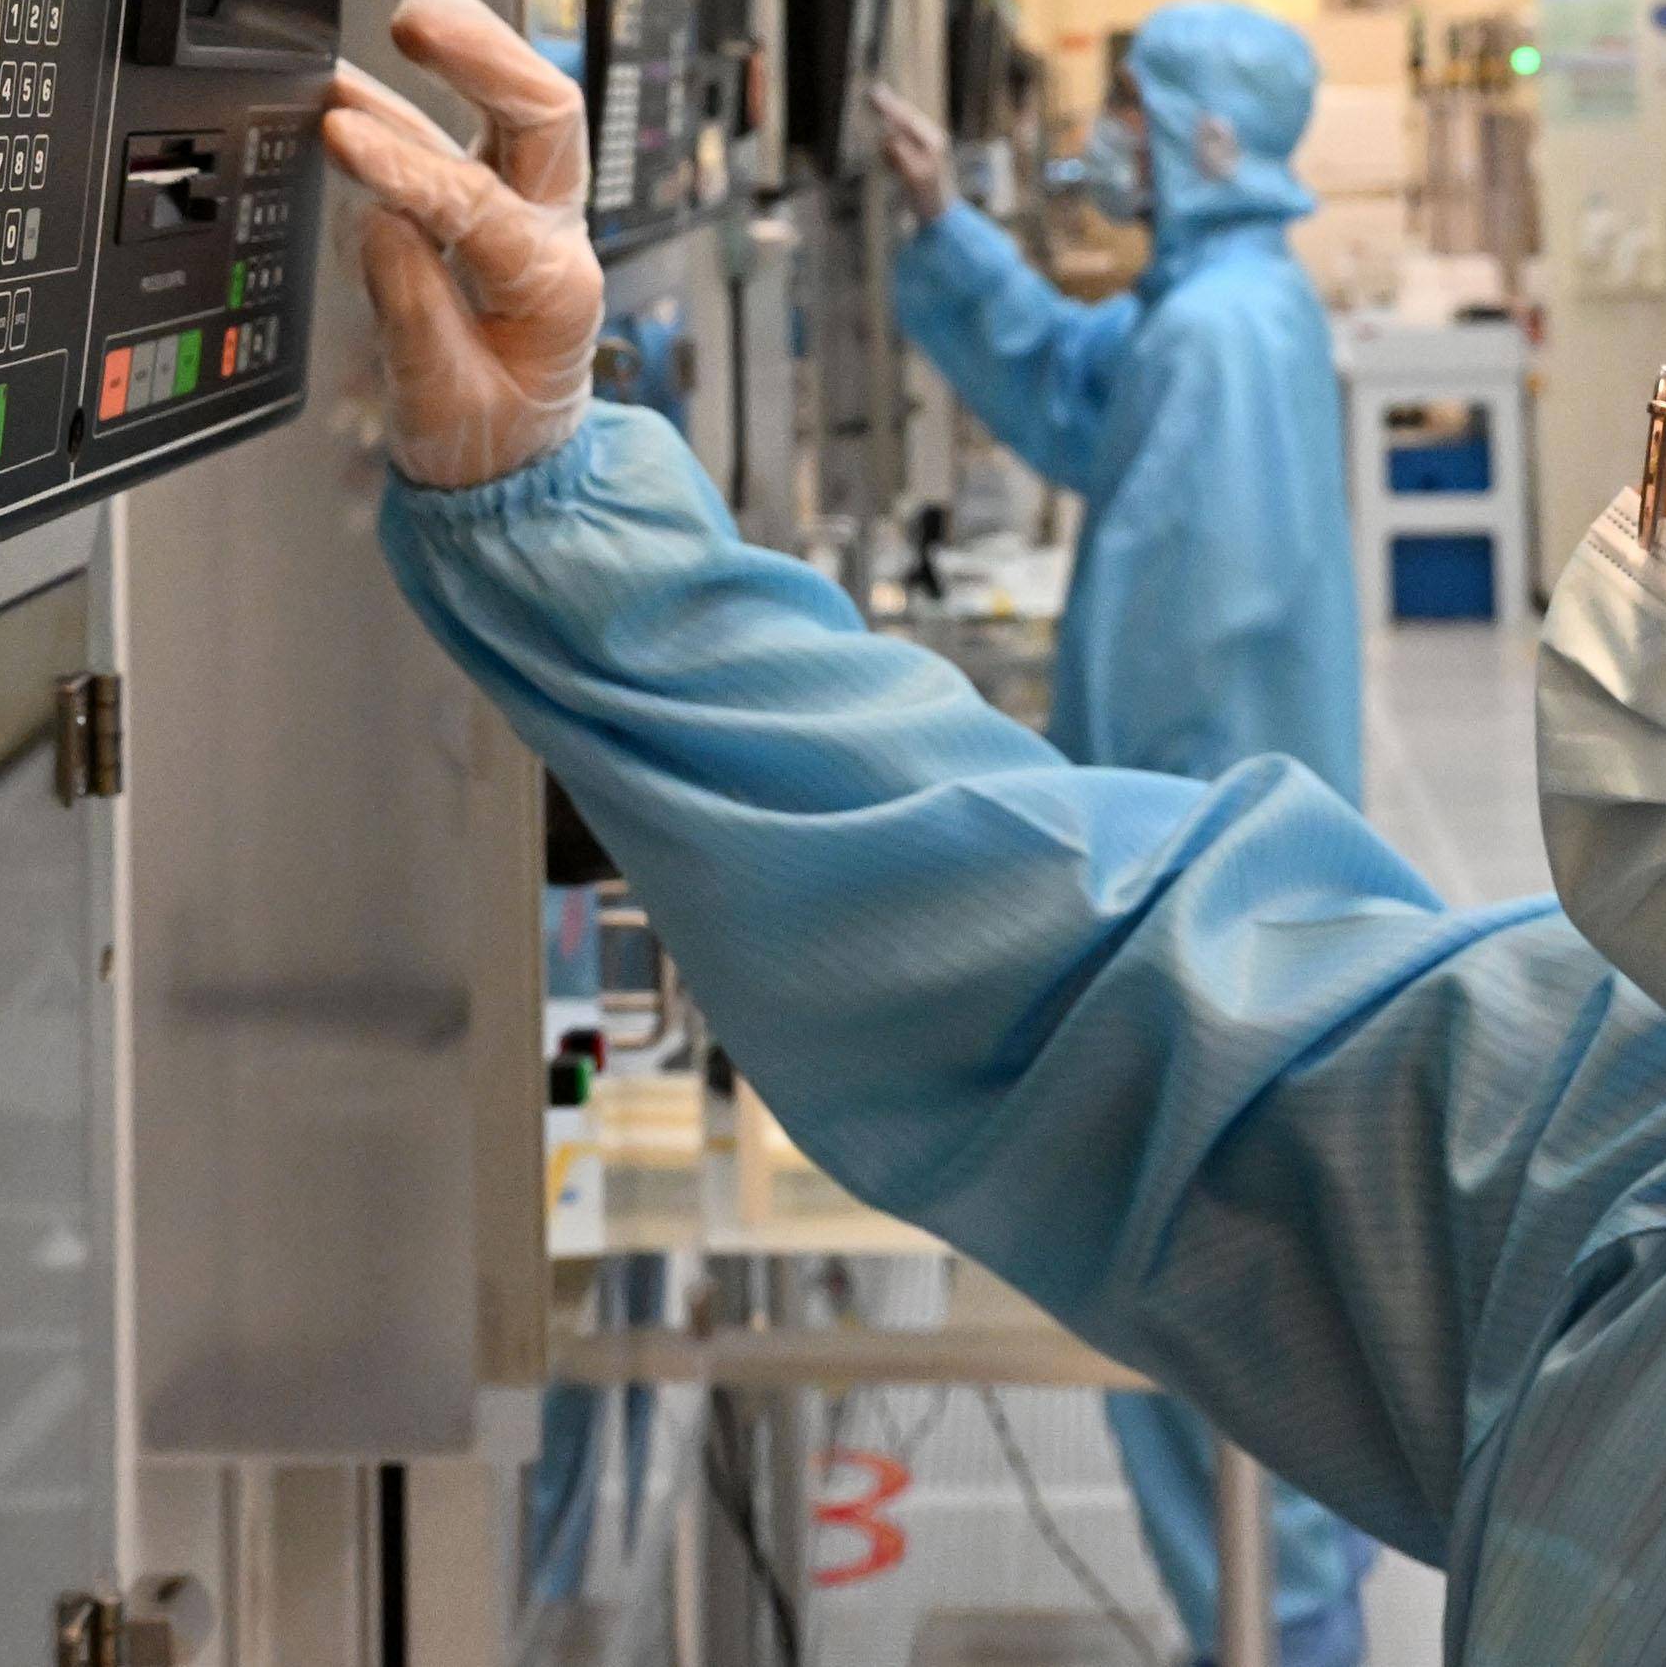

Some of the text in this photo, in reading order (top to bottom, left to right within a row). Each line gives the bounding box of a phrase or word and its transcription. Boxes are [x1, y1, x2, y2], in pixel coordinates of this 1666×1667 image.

[10, 3, 19, 27] 1
[29, 4, 40, 29] 2
[49, 7, 59, 30] 3
[1, 77, 12, 102] 4
[22, 78, 32, 102] 5
[42, 78, 52, 102] 6
[14, 151, 24, 176] 8
[34, 150, 44, 174] 9
[6, 224, 17, 249] 0
